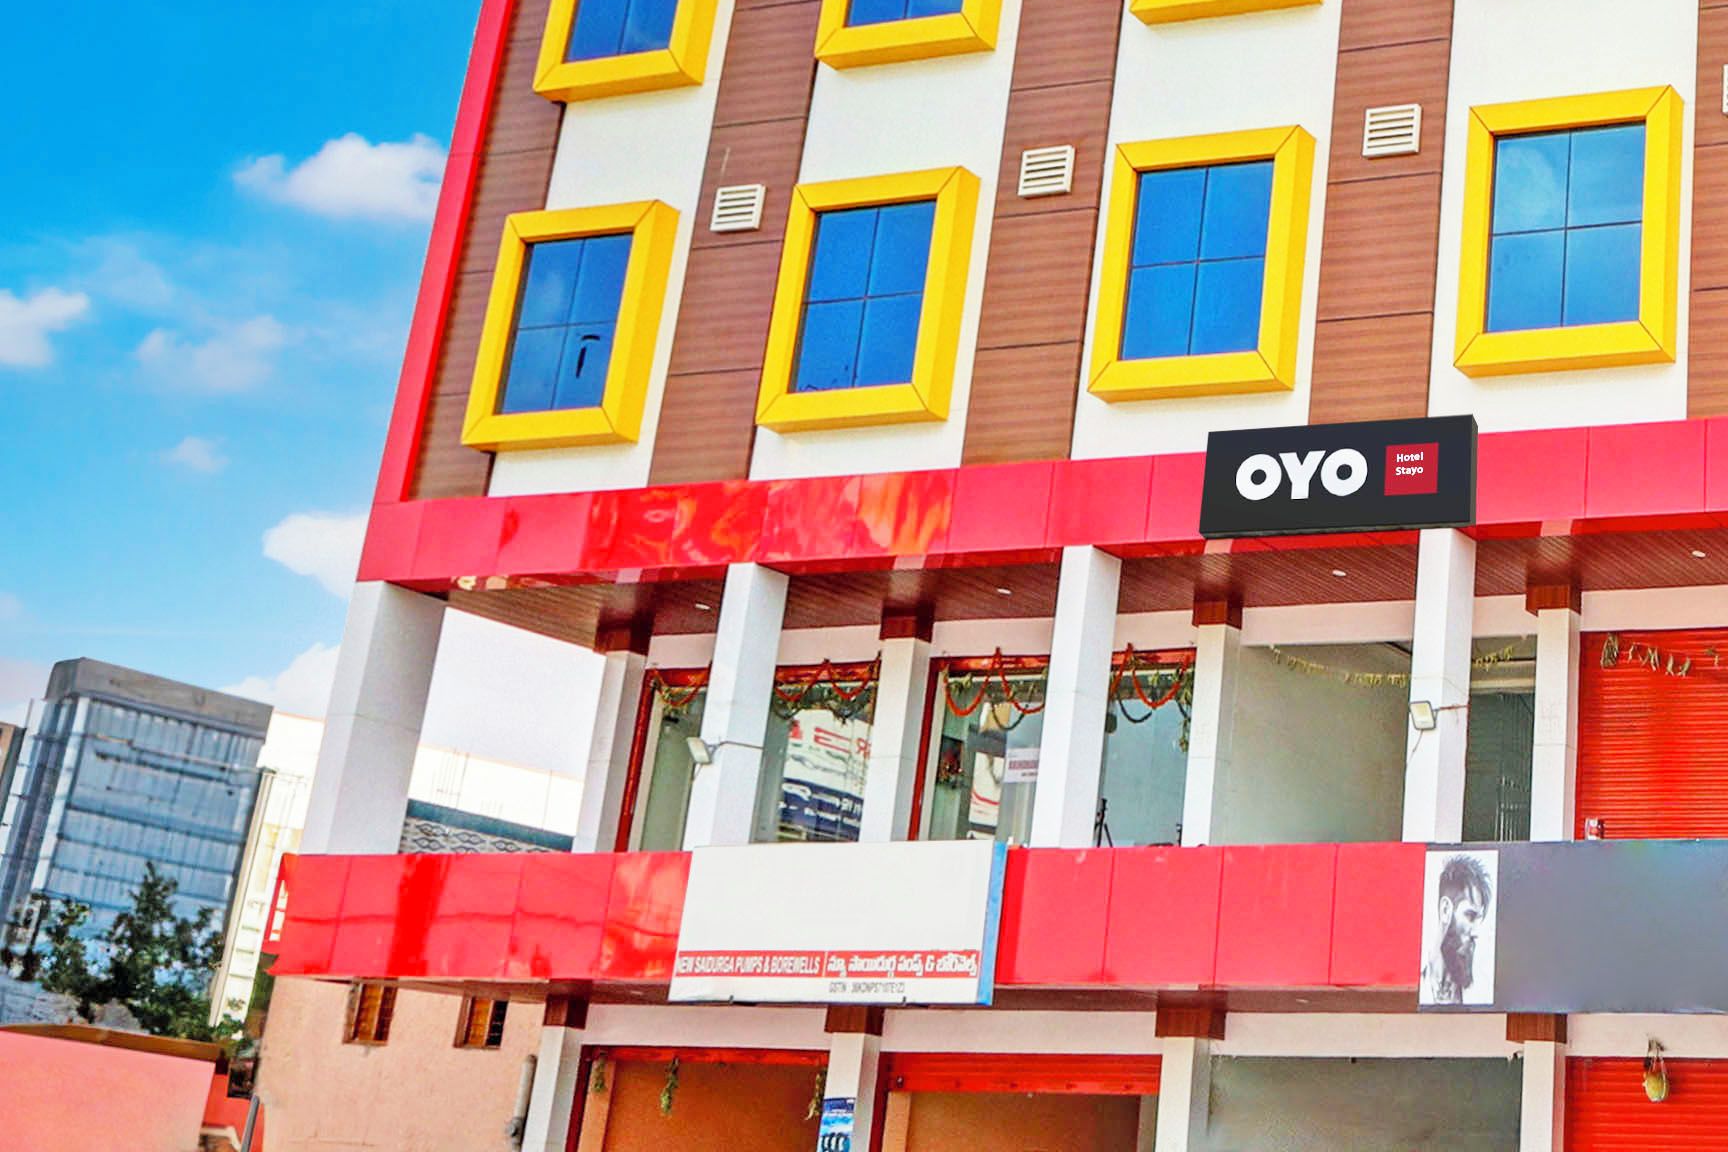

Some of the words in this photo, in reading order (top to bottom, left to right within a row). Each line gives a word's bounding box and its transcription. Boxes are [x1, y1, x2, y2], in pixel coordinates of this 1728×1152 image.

[1396, 451, 1424, 463] Hotel
[1235, 448, 1368, 501] OYO
[1395, 464, 1424, 477] Stayo
[734, 956, 761, 974] PUMPS
[769, 956, 820, 974] BOREWELLS
